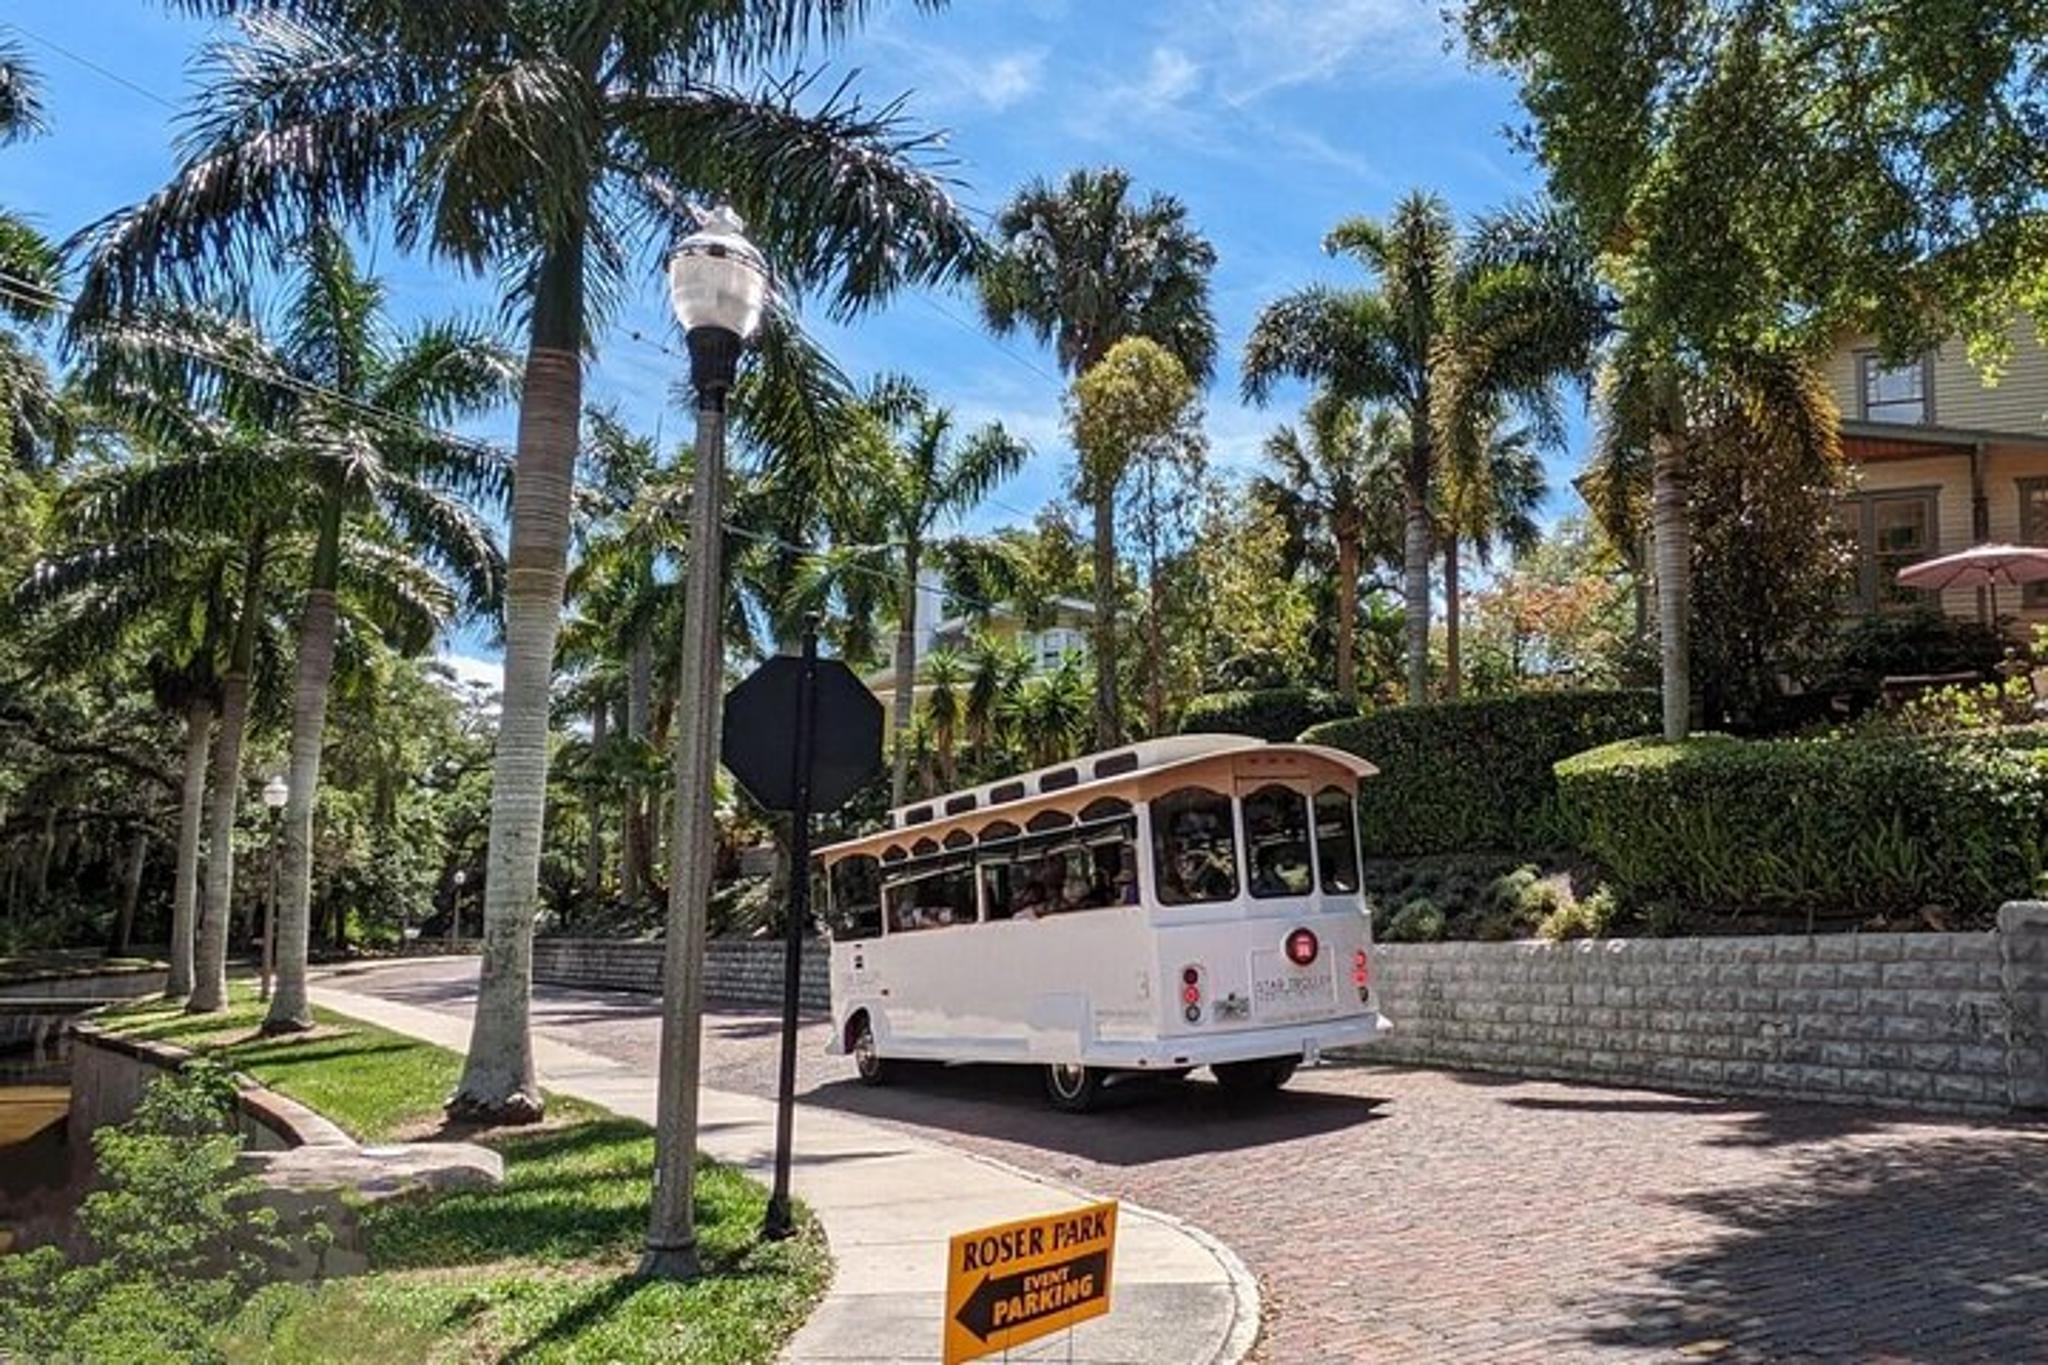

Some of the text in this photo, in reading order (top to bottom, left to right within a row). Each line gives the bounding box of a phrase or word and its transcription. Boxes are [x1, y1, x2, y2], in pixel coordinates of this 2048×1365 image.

[963, 1211, 1107, 1272] ROSER PARK
[992, 1274, 1093, 1326] PARKING
[1023, 1267, 1070, 1292] EVENT
